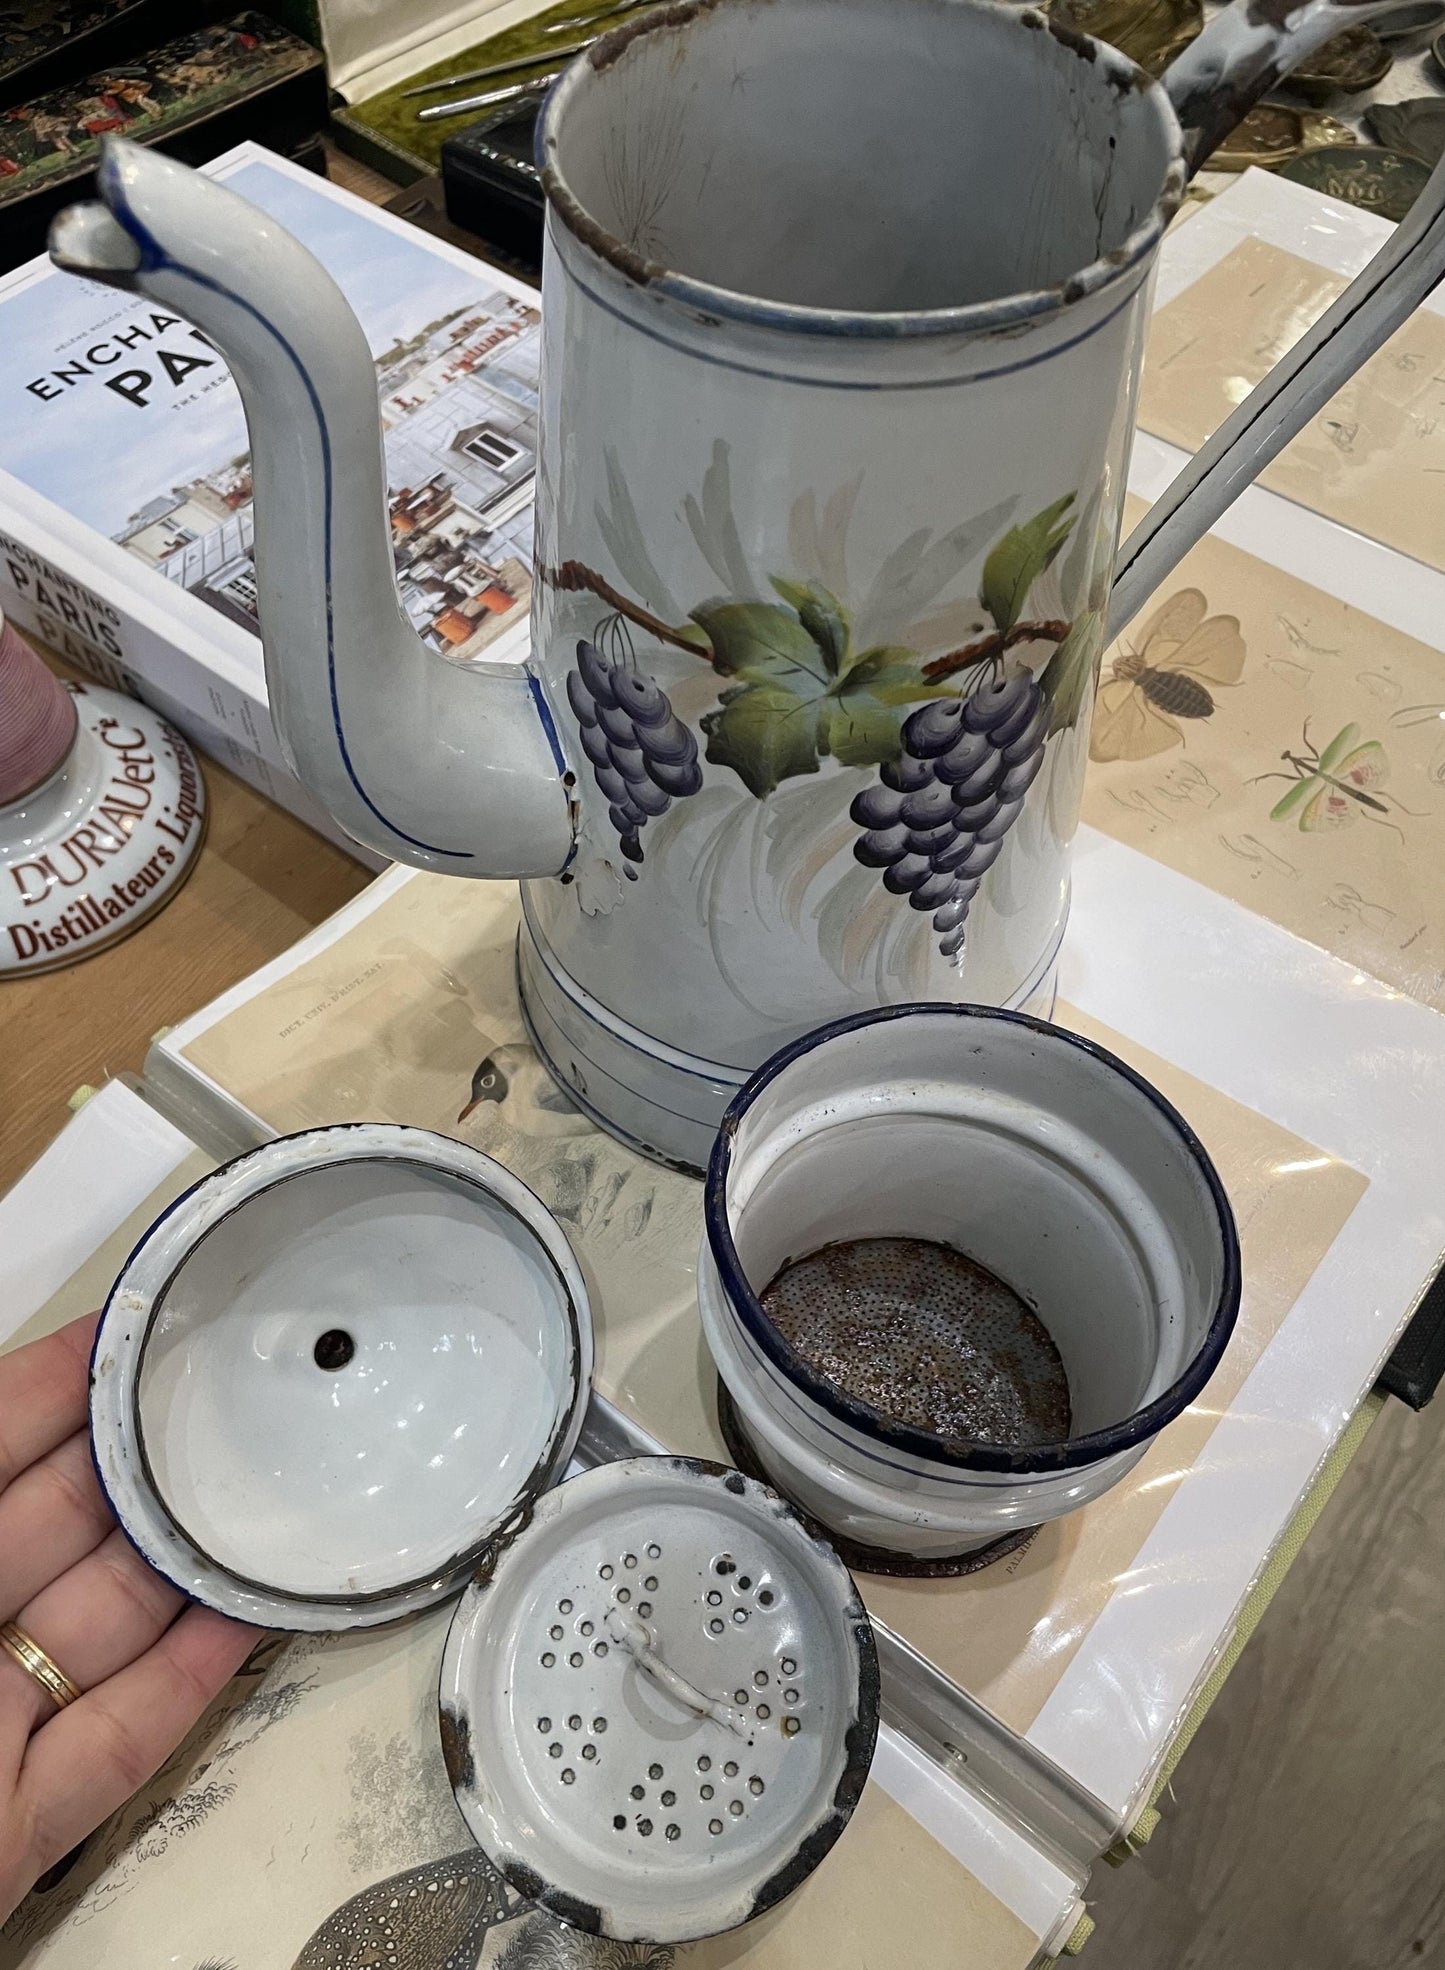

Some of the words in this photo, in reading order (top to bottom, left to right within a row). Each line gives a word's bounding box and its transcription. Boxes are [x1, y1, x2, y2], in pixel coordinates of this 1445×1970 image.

[26, 312, 182, 402] ENCHA
[104, 329, 224, 409] PA
[0, 538, 121, 627] NCHANTING
[6, 557, 124, 659] PARIS
[9, 777, 153, 907] DURIAU
[7, 844, 176, 960] Distillateurs
